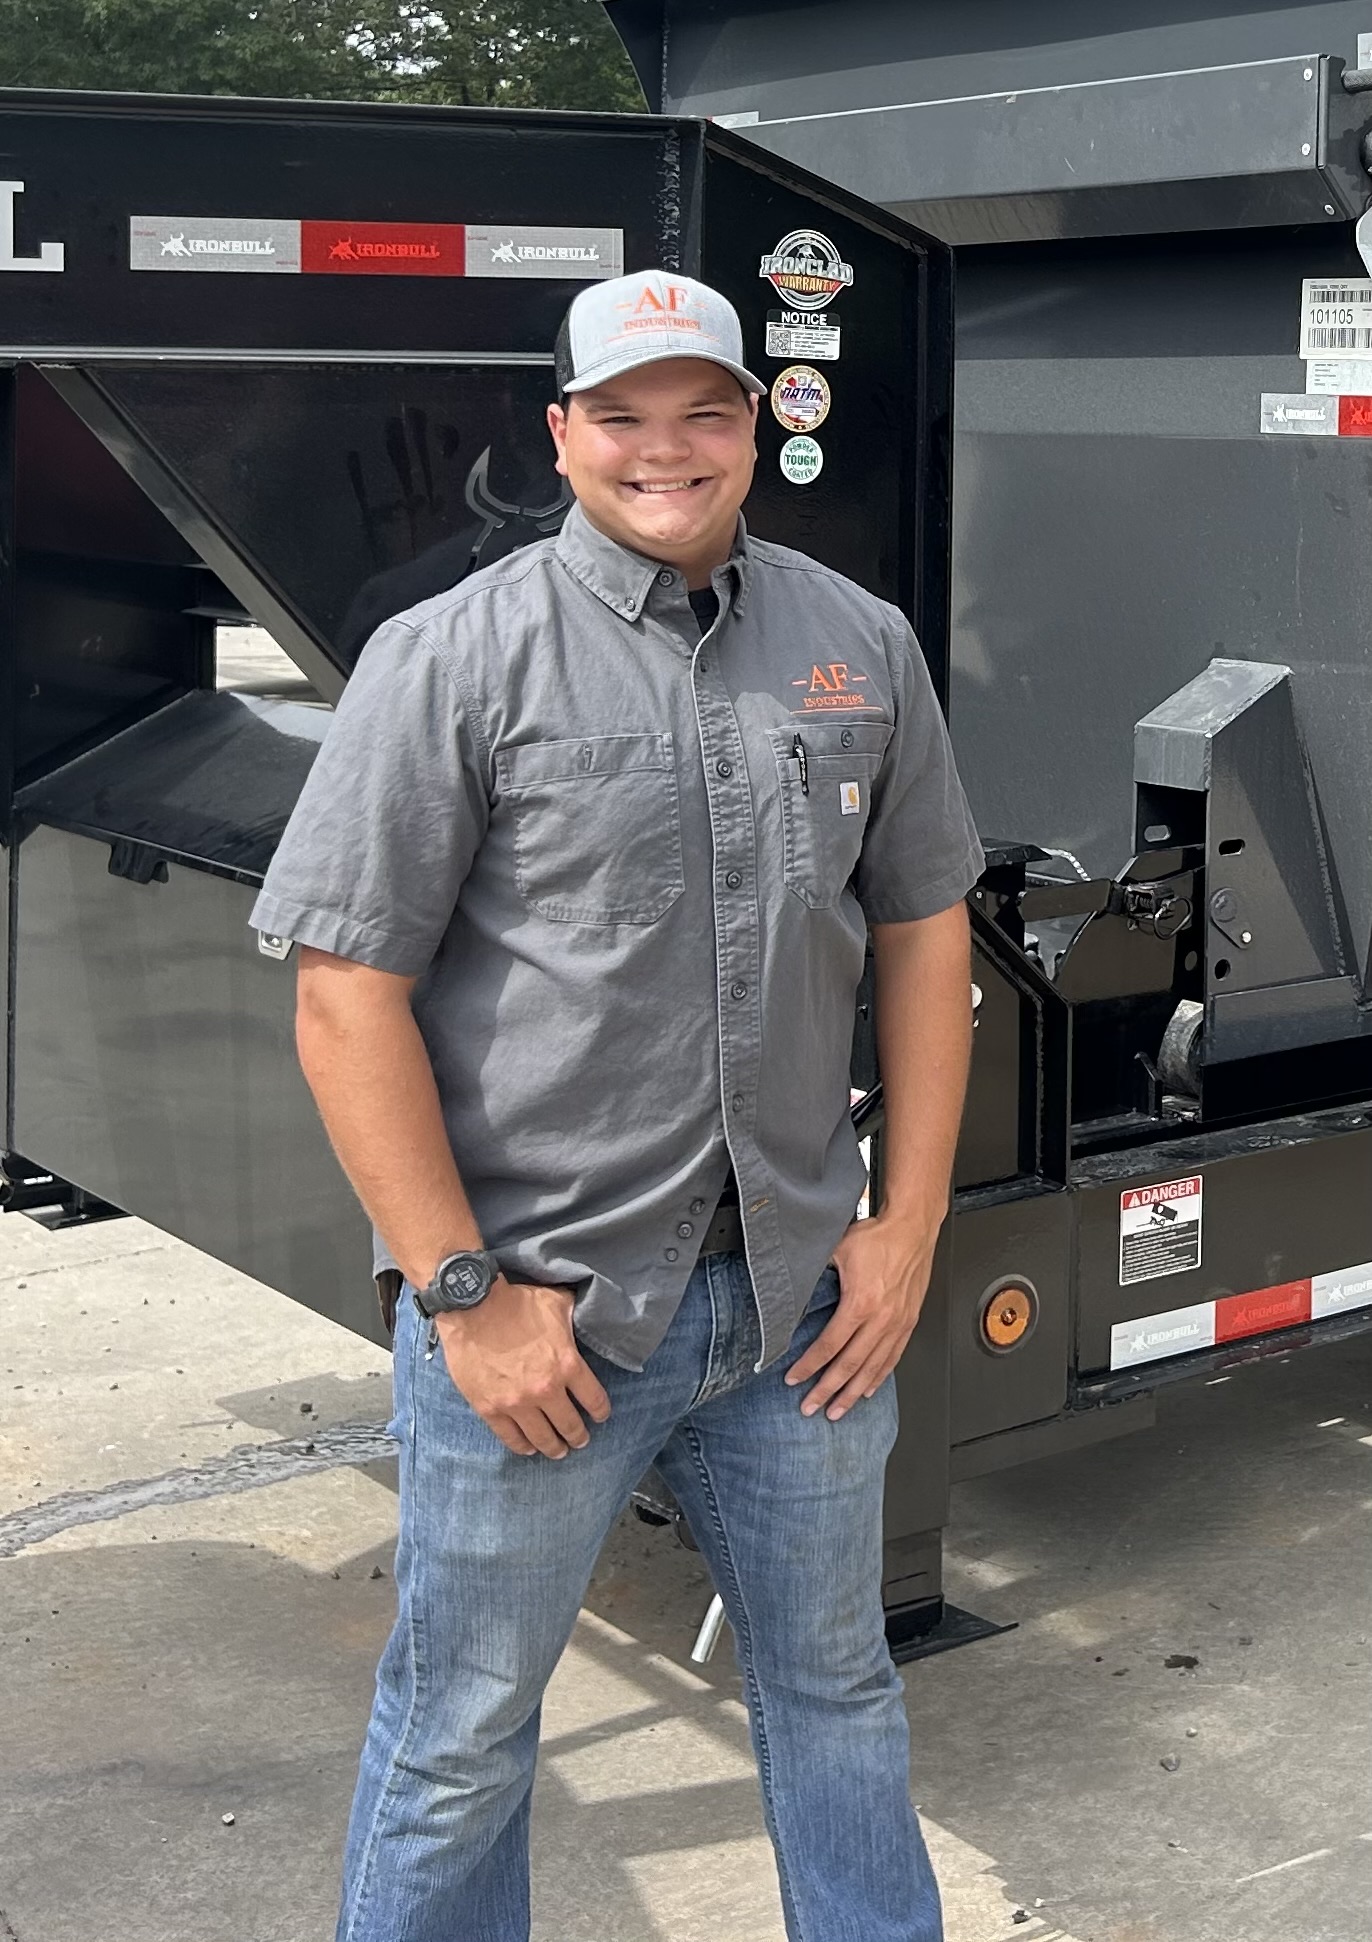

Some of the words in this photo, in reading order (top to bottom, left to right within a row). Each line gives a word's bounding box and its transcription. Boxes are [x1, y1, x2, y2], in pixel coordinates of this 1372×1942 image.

[188, 239, 275, 254] IRONBULL
[356, 243, 440, 258] IRONBULL
[517, 246, 600, 261] IRONBULL
[762, 256, 852, 283] IRONCLAD
[779, 275, 836, 292] WARRANTY
[632, 285, 689, 314] AF
[781, 311, 828, 326] NOTICE
[1309, 308, 1354, 325] 101105
[785, 454, 818, 467] TOUGH
[808, 663, 849, 692] AF
[1141, 1181, 1195, 1205] DANGER
[1146, 1322, 1200, 1345] IRONBULL
